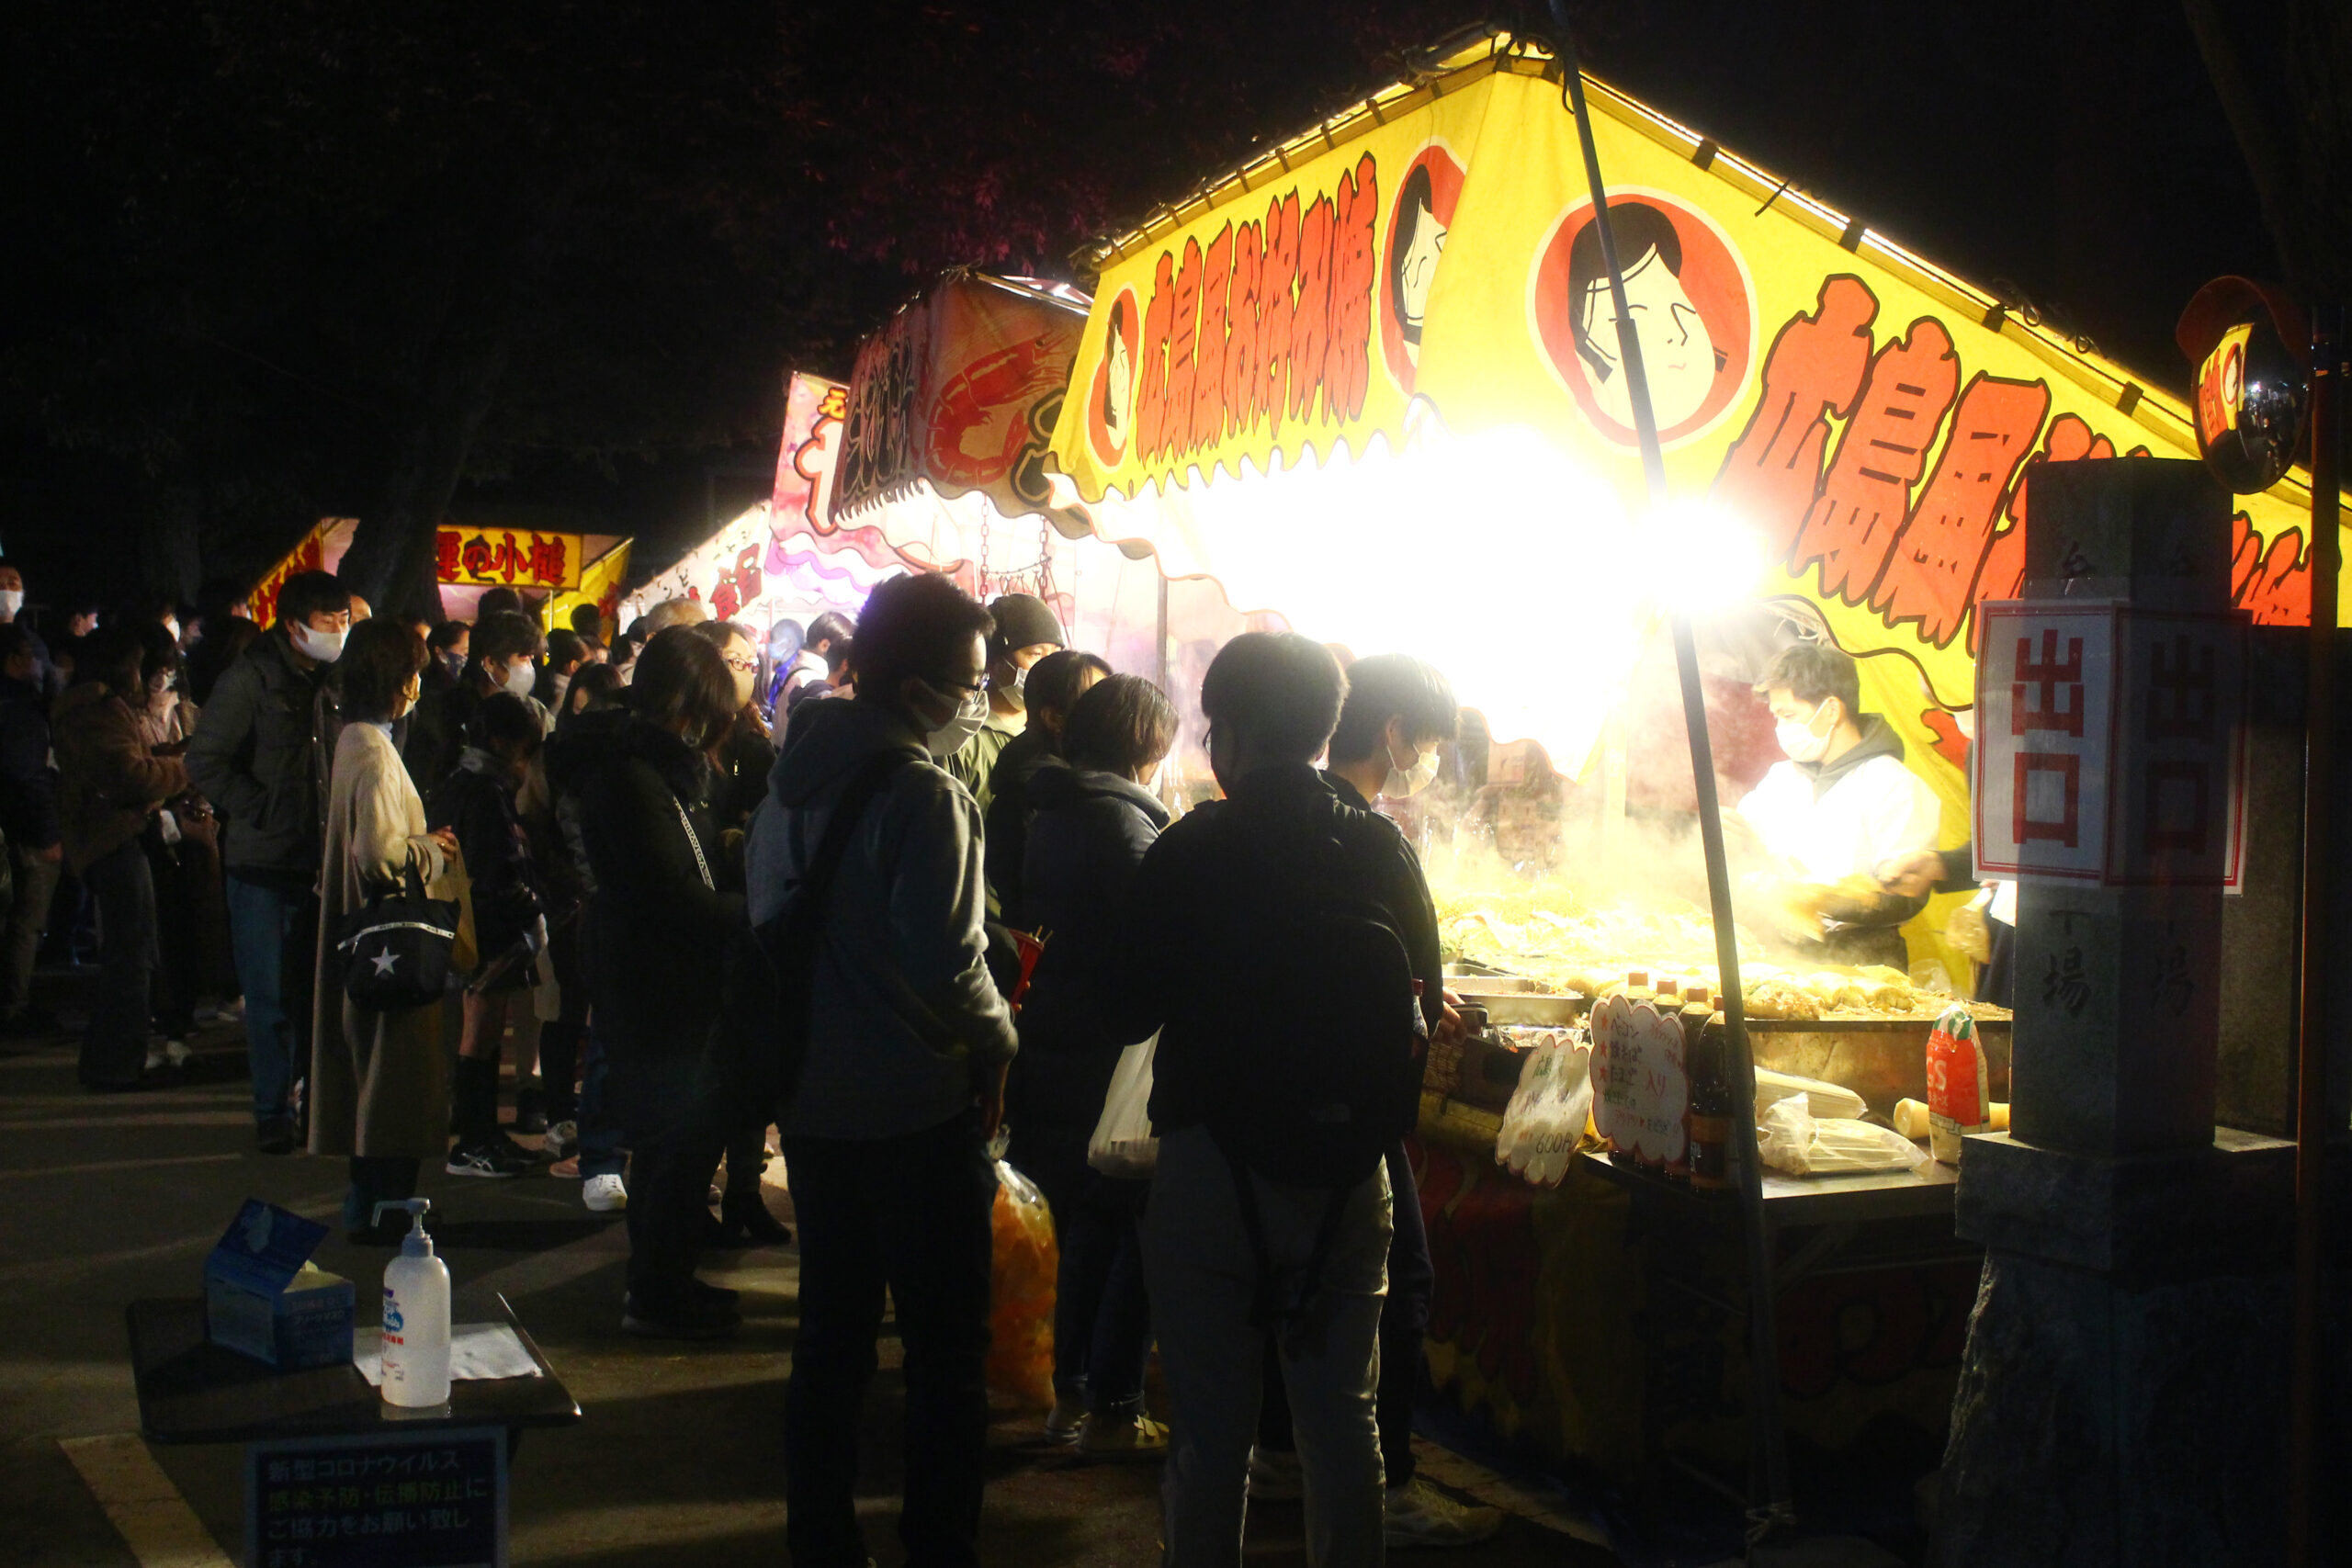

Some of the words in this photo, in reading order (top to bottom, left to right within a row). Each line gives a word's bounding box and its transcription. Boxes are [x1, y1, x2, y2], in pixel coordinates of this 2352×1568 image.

[2011, 628, 2085, 848] 出口
[2145, 634, 2215, 855] 出口
[266, 1507, 470, 1540] ご協力をお願い致し
[268, 1450, 460, 1483] 新型コロナウイルス
